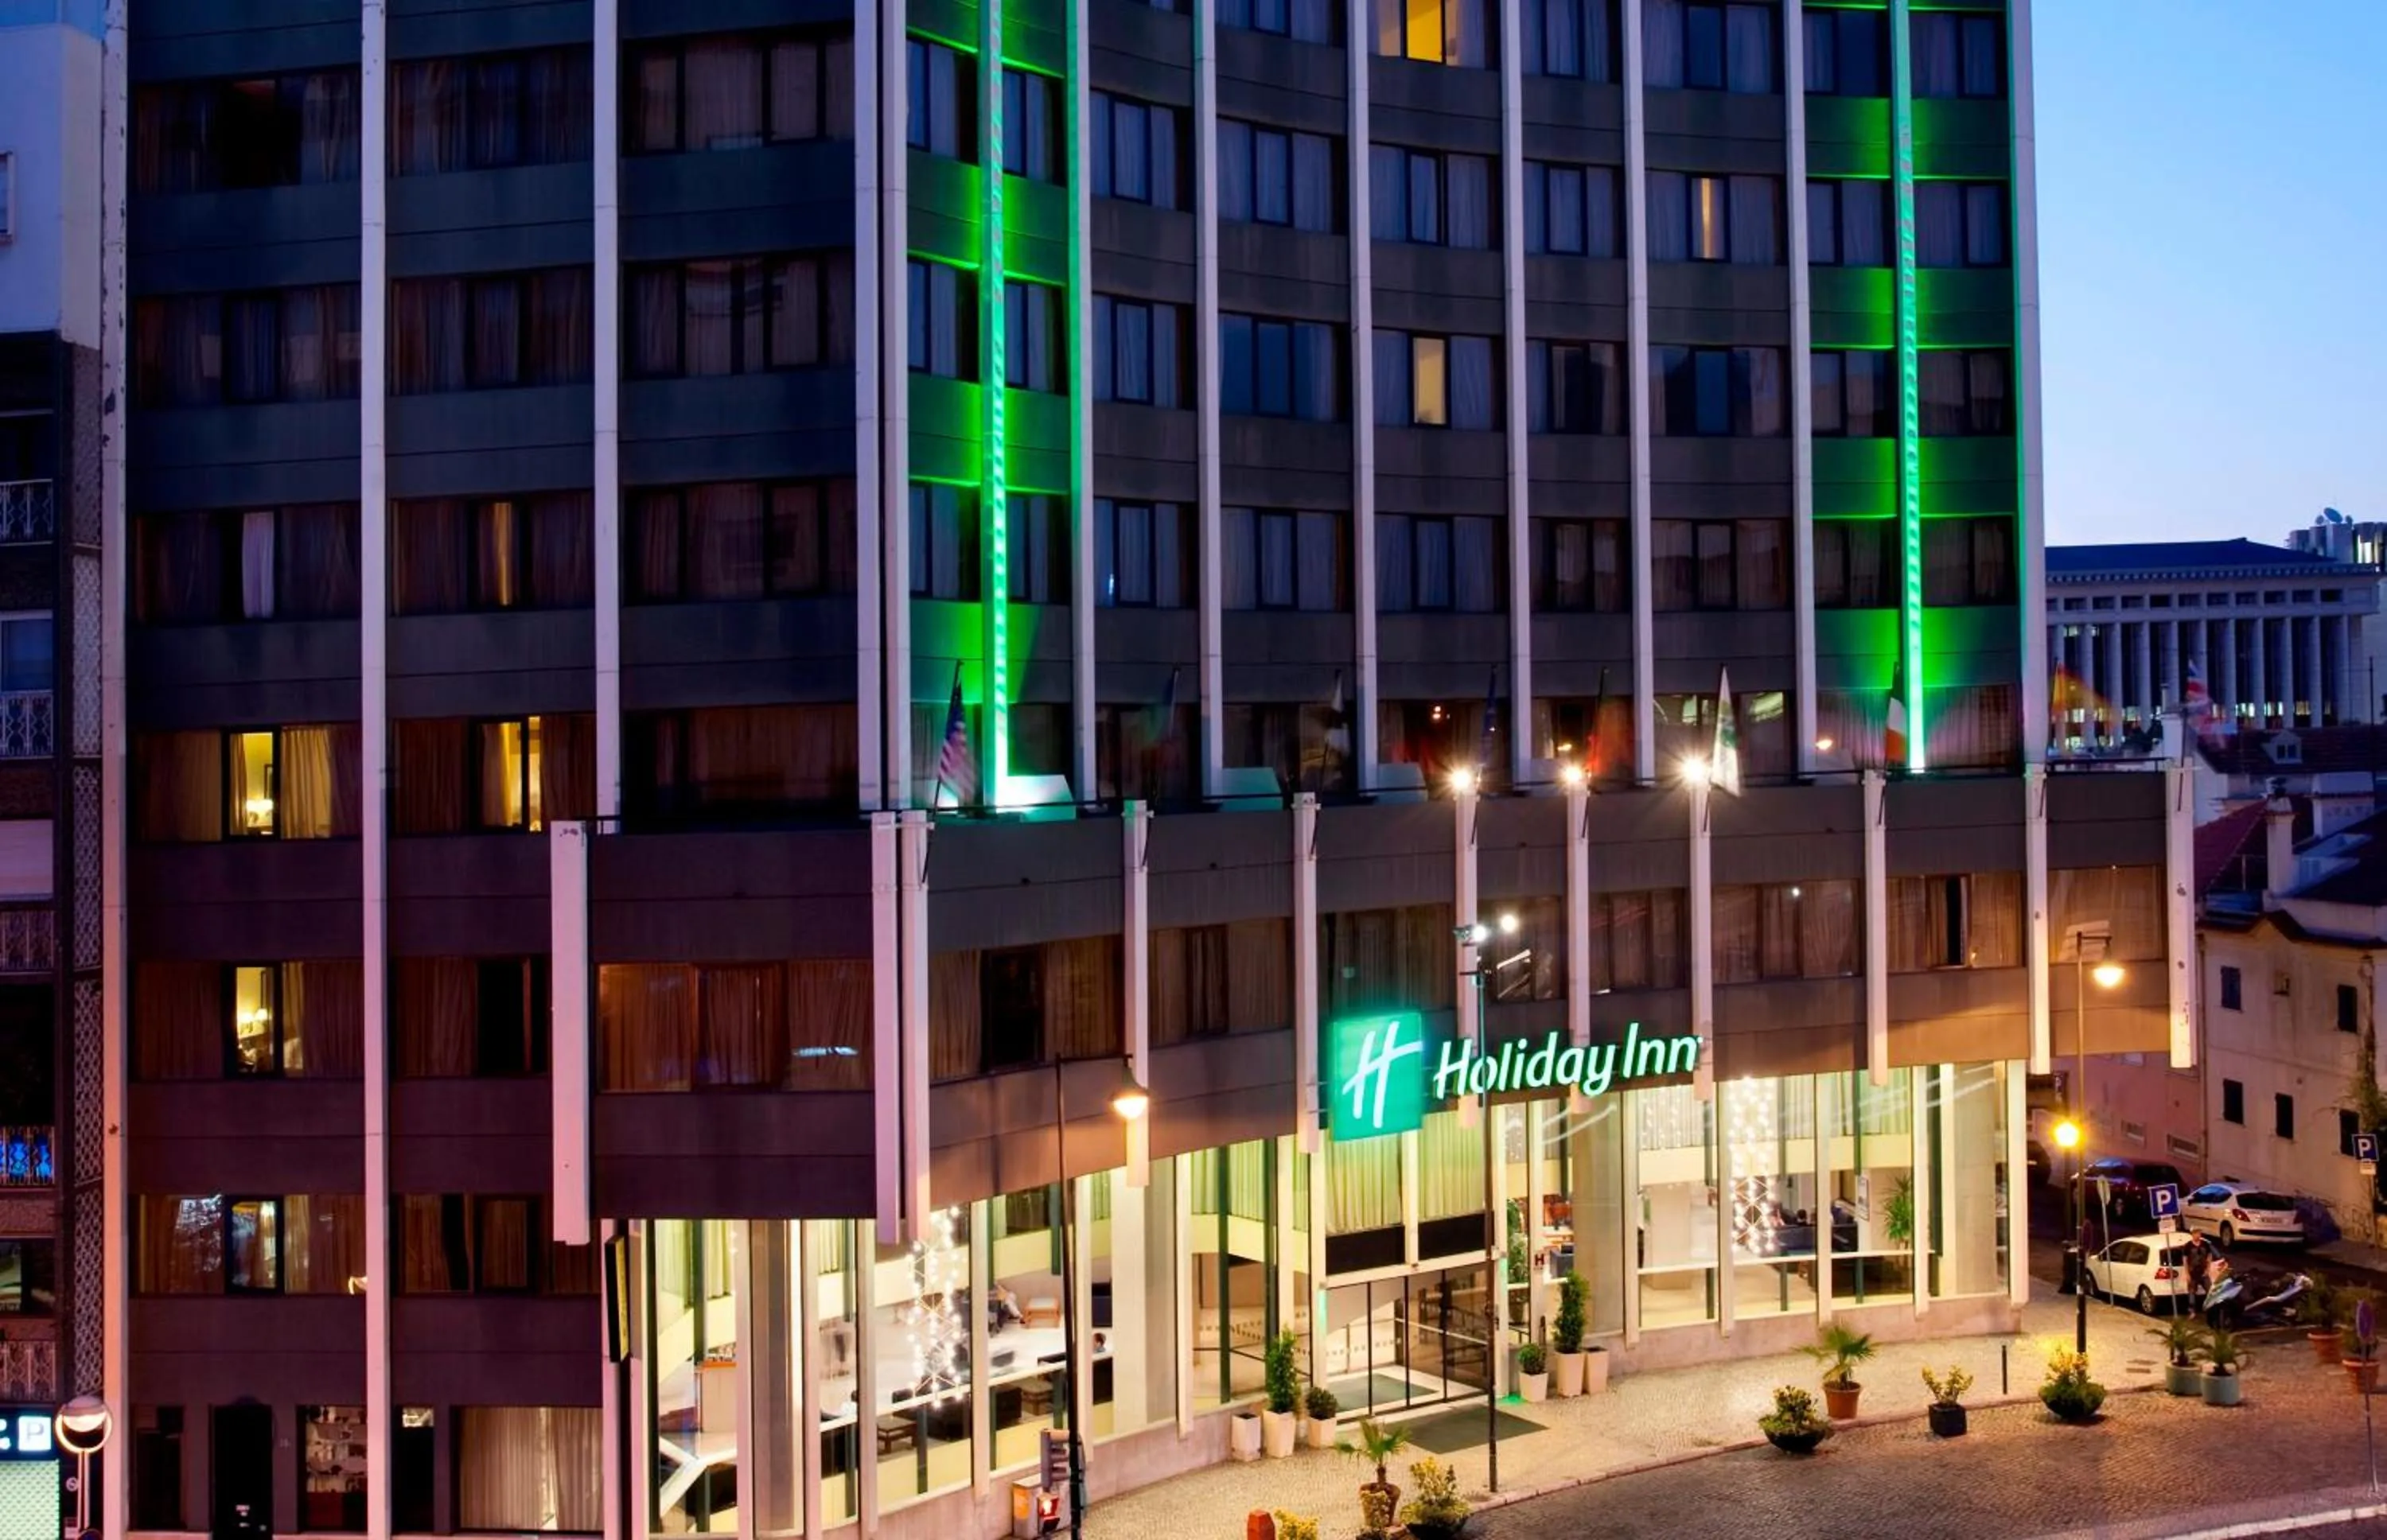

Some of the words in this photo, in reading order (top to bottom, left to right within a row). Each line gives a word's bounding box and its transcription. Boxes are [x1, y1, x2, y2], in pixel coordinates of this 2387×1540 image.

[1432, 1032, 1615, 1096] Holiday
[1622, 1022, 1700, 1079] Inn
[2358, 1138, 2372, 1157] P
[2155, 1189, 2171, 1213] P
